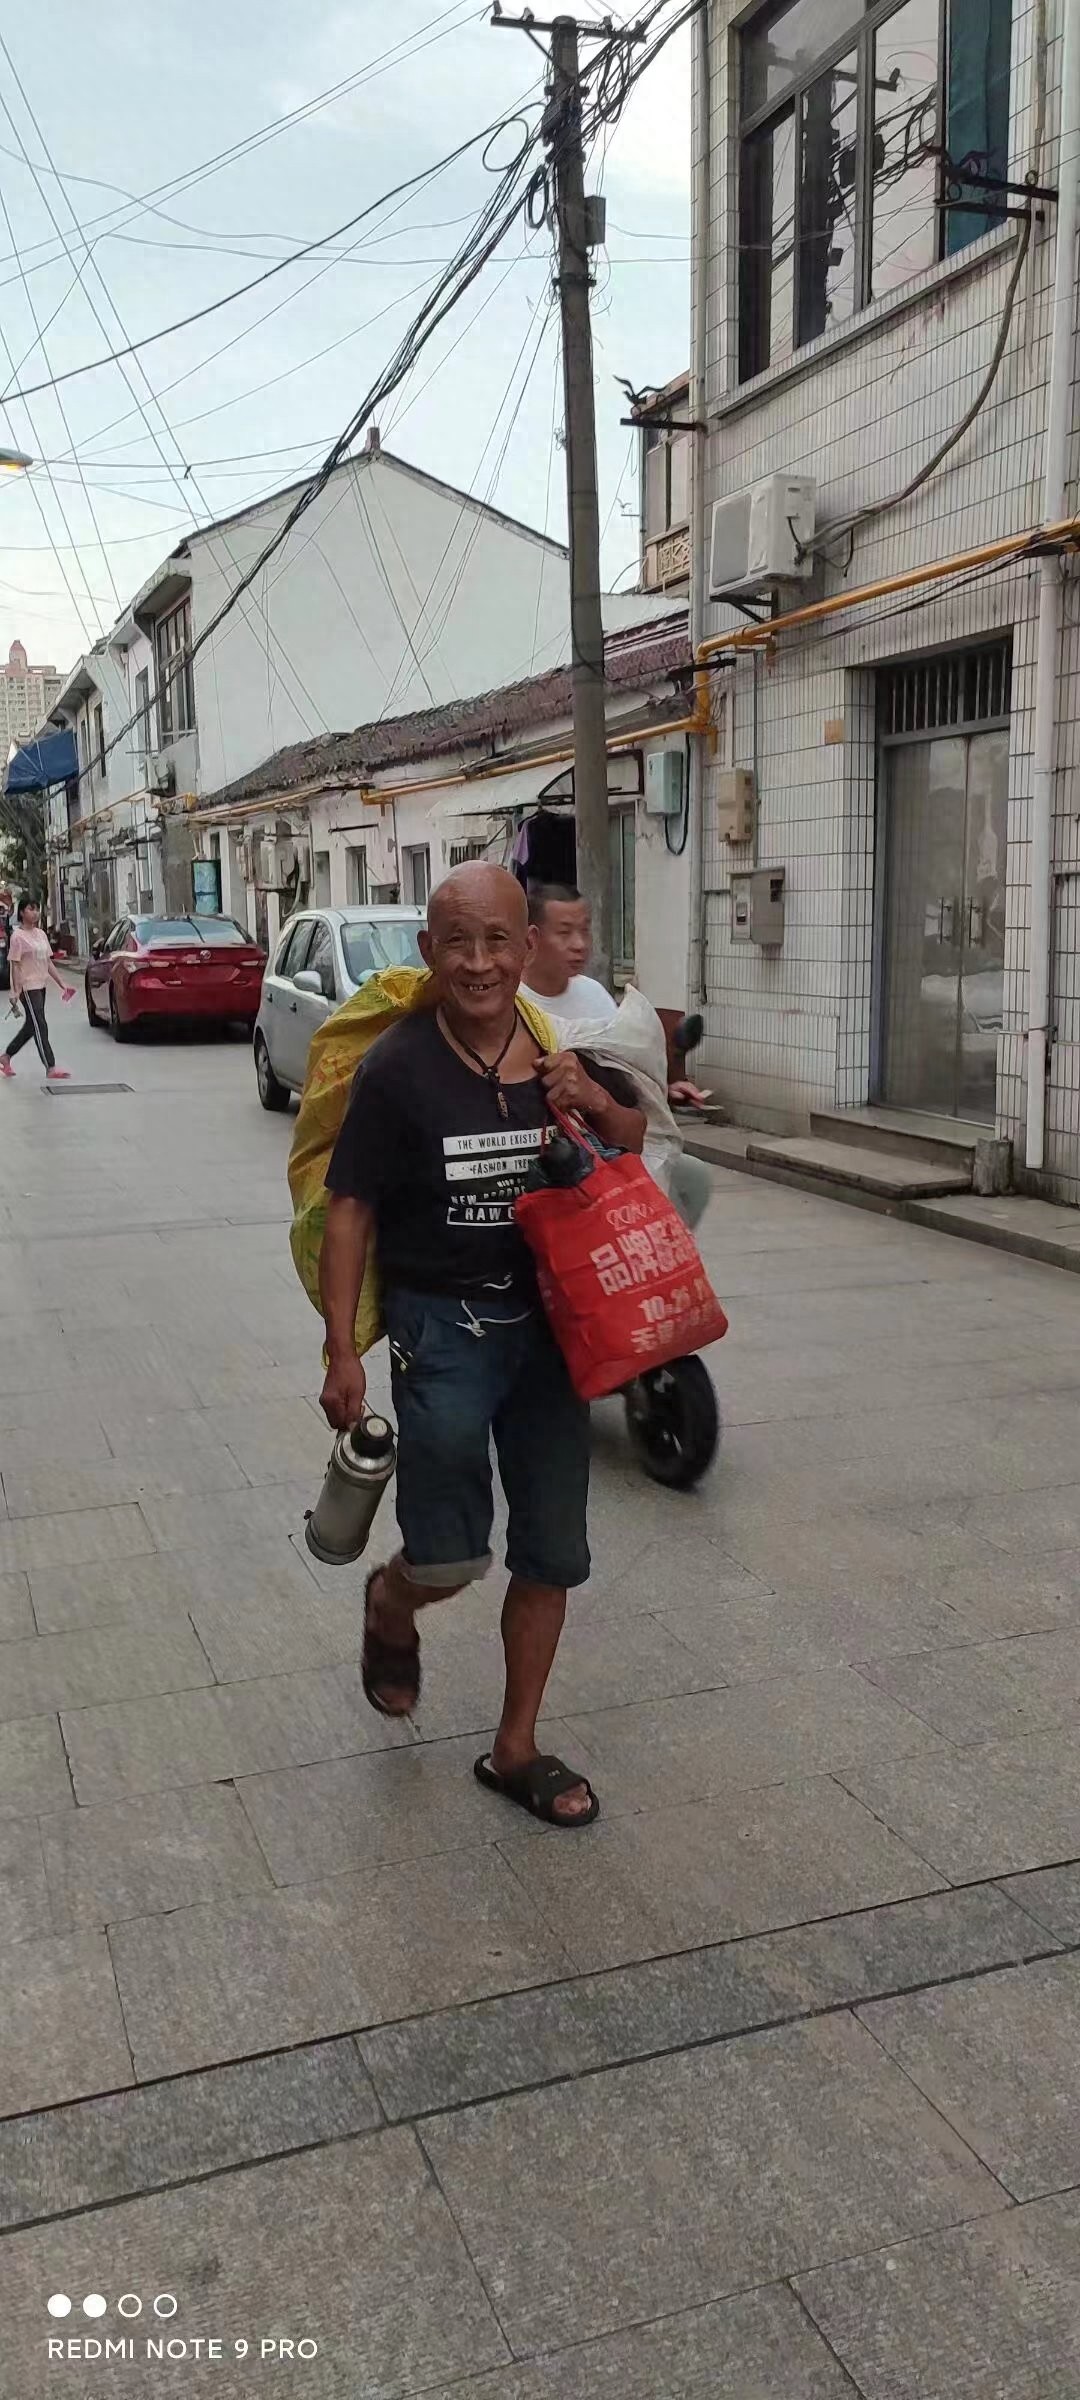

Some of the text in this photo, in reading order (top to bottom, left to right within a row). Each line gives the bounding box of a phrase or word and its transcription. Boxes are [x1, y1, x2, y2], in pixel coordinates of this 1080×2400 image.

[457, 1139, 474, 1151] THE
[478, 1136, 507, 1149] WORLD
[510, 1132, 538, 1148] EXISTS
[472, 1161, 507, 1175] FASHION
[465, 1207, 502, 1221] RAW
